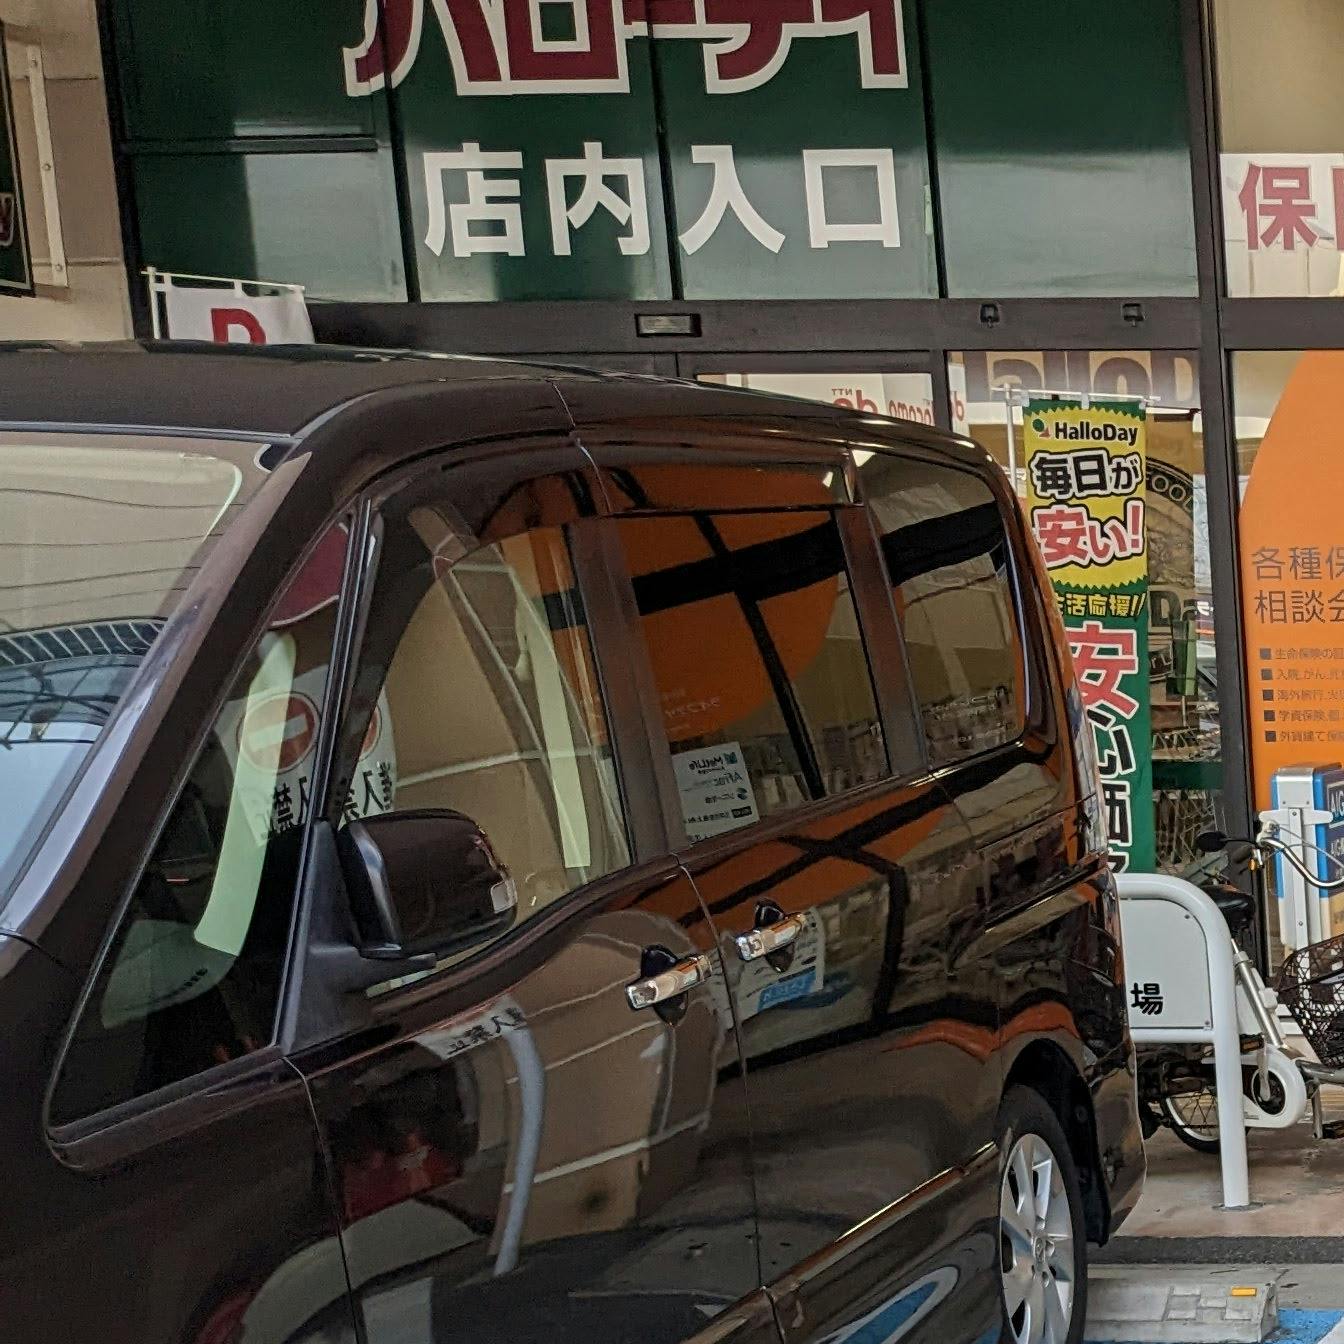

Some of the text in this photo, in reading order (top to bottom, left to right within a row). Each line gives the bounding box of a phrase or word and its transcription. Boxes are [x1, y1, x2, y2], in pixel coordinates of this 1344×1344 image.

[422, 141, 901, 258] 店内入口
[1054, 421, 1139, 446] HalloDay
[1032, 450, 1142, 499] 毎日が
[1130, 982, 1164, 1016] 場
